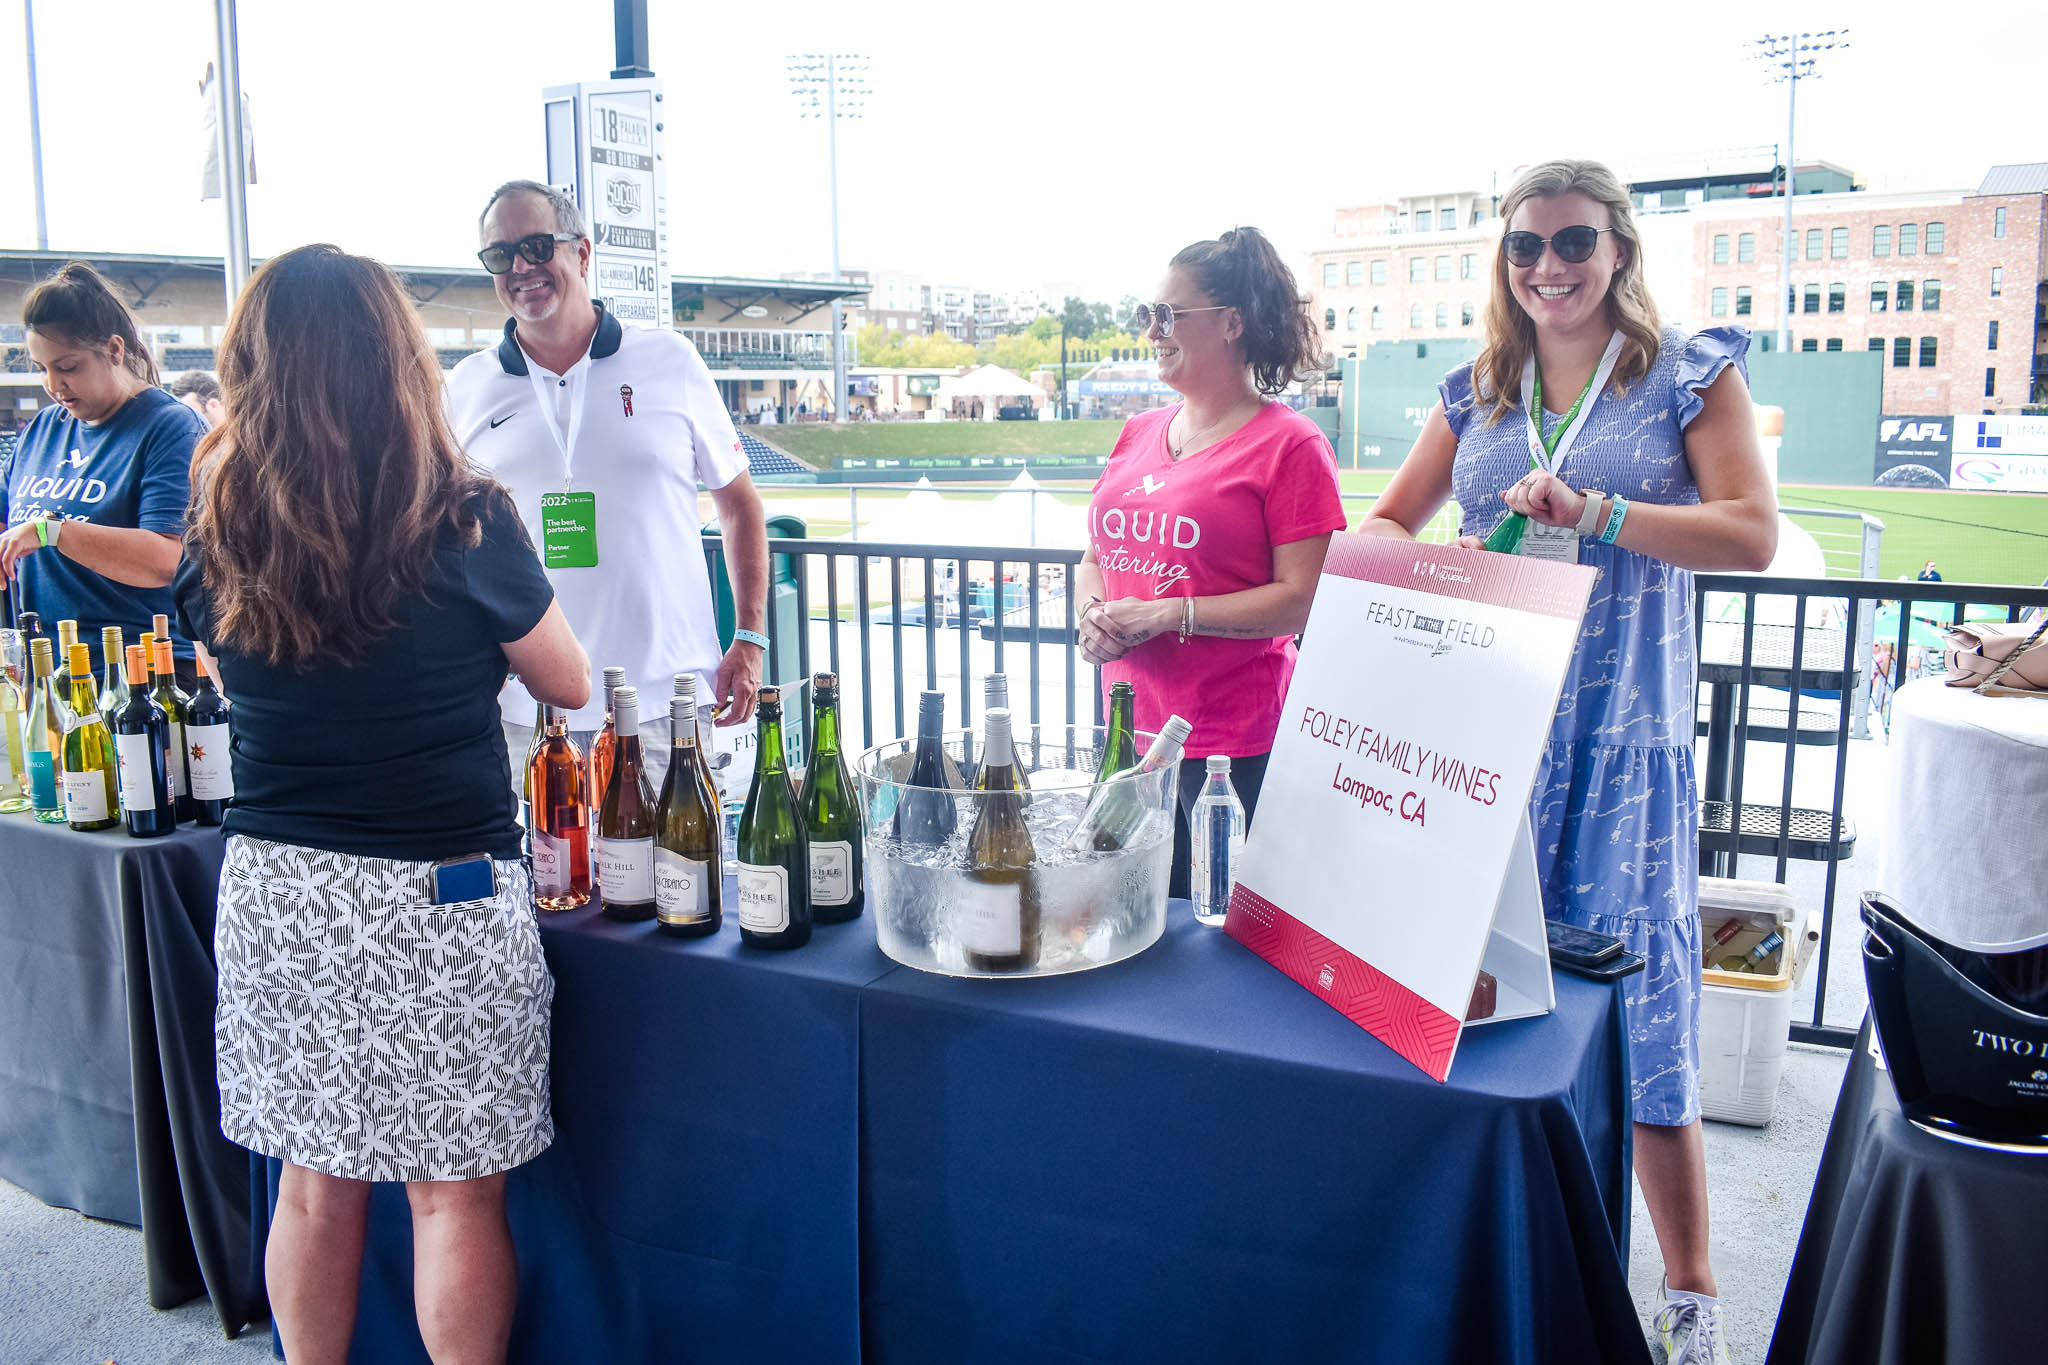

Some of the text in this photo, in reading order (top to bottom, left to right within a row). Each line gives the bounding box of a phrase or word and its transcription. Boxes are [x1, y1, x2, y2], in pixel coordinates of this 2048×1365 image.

[600, 107, 618, 144] 18
[633, 264, 655, 292] 146
[15, 475, 107, 504] LIQUID
[541, 496, 568, 507] 2022
[546, 518, 576, 527] The best
[1089, 506, 1201, 549] IQUID
[1366, 602, 1415, 630] FEAST
[1445, 618, 1496, 648] FIELD
[1300, 706, 1502, 806] FOLEY FAMILY WINES
[1332, 762, 1426, 828] Lompoc, CA
[614, 862, 636, 871] HILL
[1973, 1029, 2034, 1055] TWO
